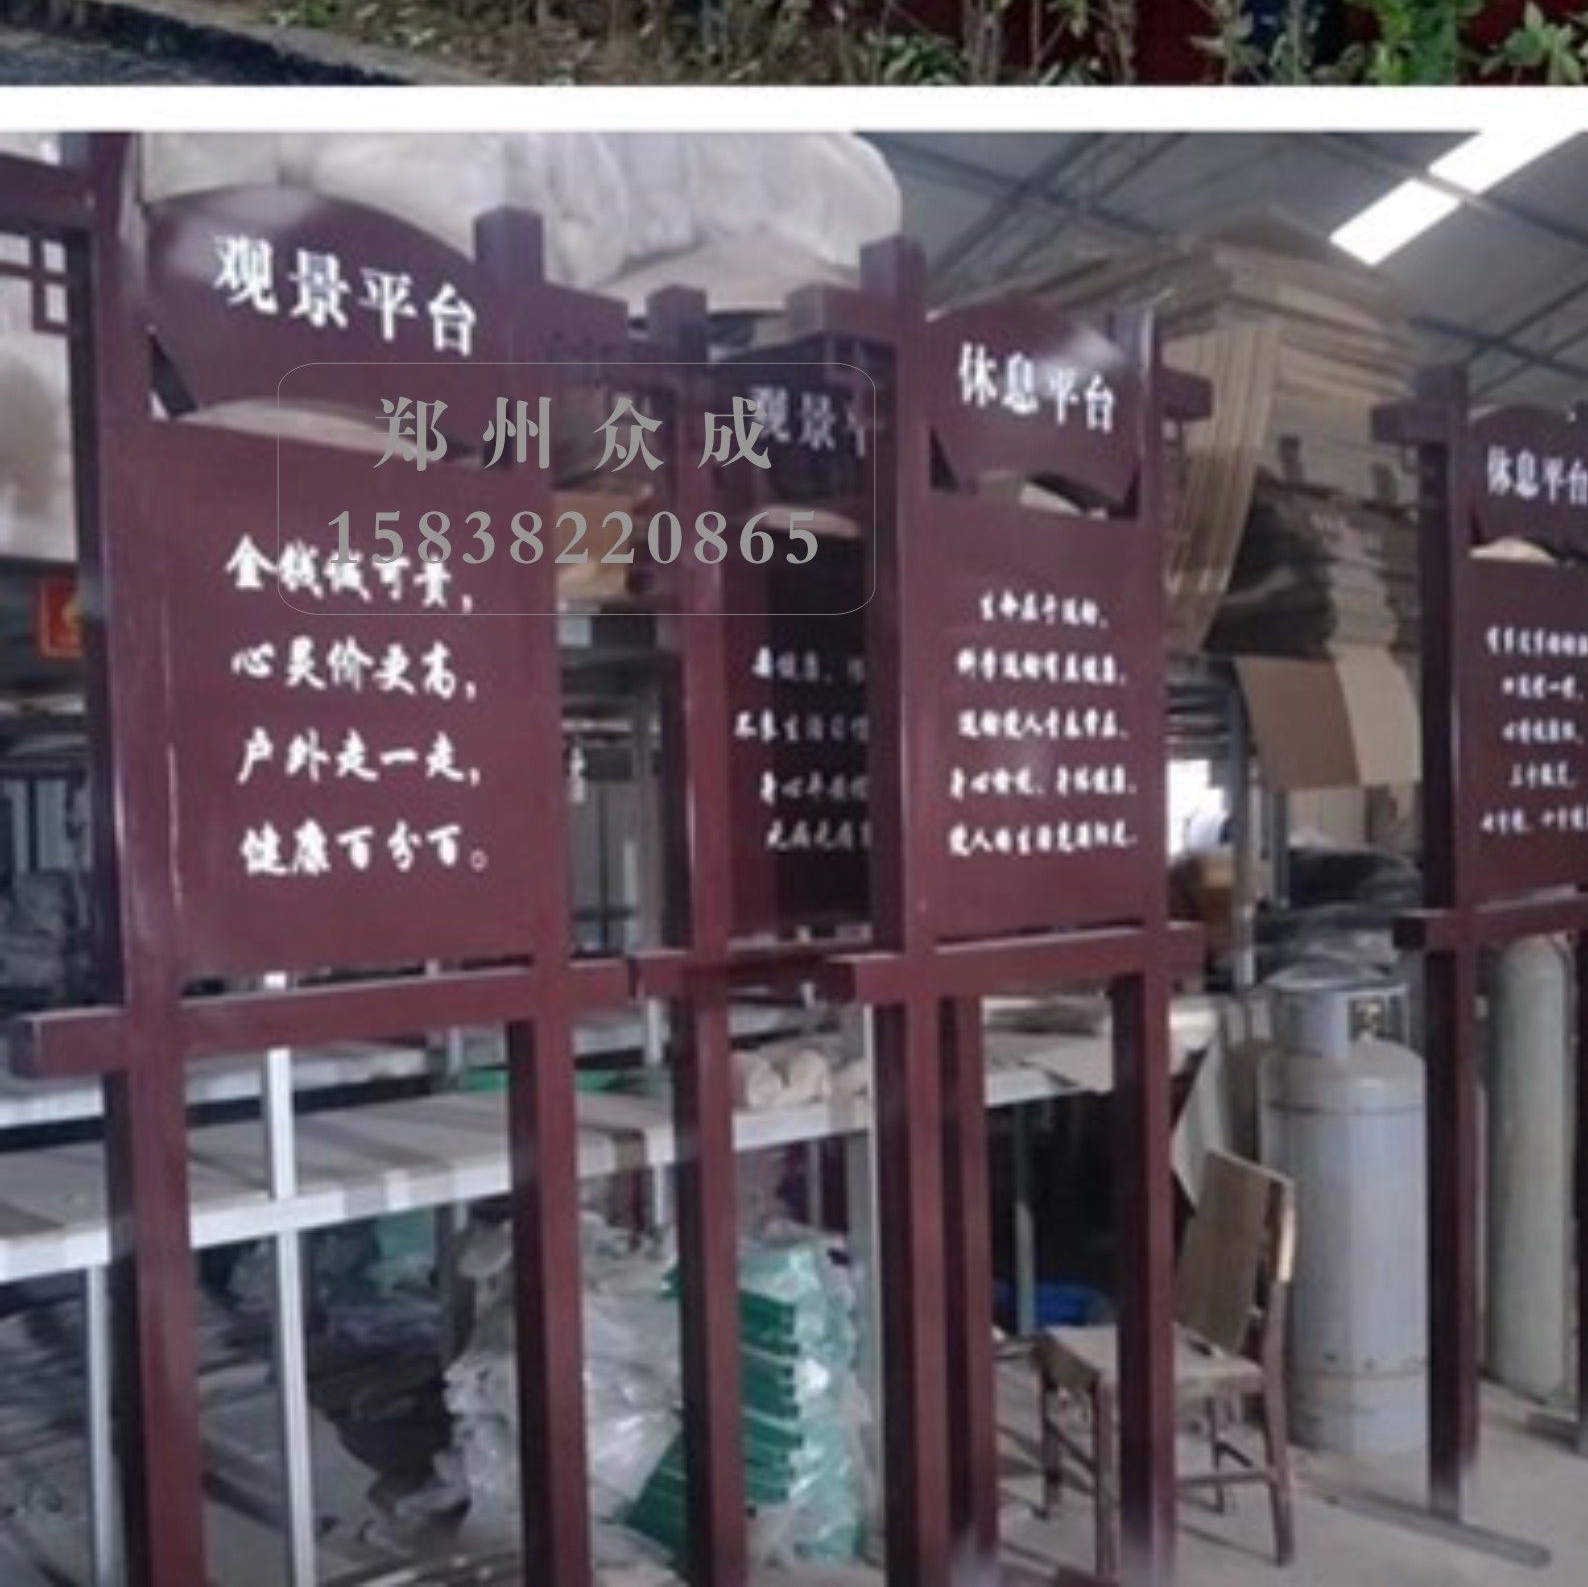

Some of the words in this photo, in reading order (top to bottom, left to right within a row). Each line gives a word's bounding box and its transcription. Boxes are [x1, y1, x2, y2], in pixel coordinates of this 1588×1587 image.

[213, 234, 477, 356] 观景平台
[957, 341, 1117, 434] 休息平台
